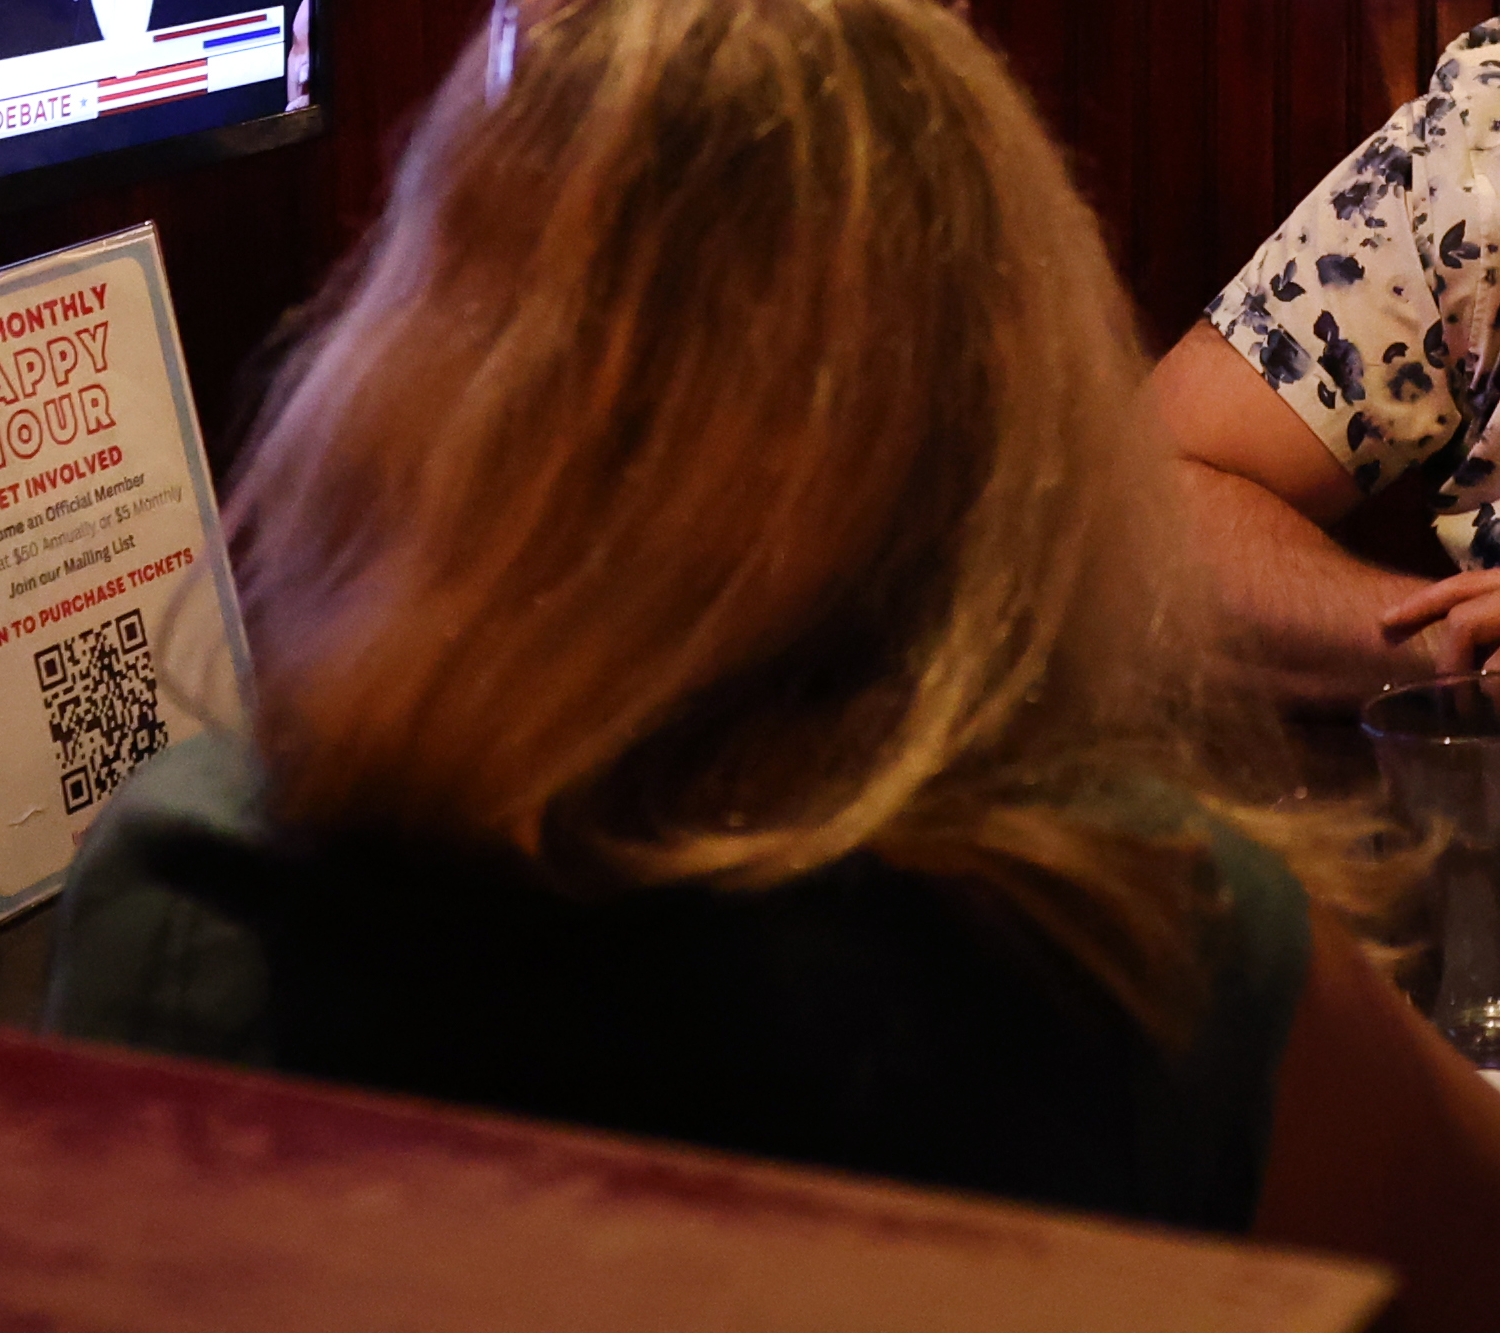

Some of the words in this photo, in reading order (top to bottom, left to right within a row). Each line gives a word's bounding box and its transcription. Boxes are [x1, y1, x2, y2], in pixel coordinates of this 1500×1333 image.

[25, 445, 123, 498] INVOLVED
[27, 515, 44, 530] an
[45, 492, 92, 522] Official
[94, 473, 144, 503] Member
[12, 541, 38, 566] $50
[42, 520, 97, 552] Annually
[99, 514, 113, 530] or
[114, 504, 131, 525] $5
[134, 485, 183, 516] Monthly
[9, 576, 38, 599] Join
[39, 566, 61, 586] our
[63, 545, 112, 576] Mailing
[112, 534, 136, 555] List
[11, 615, 36, 638] TO
[39, 576, 126, 628] PURCHASE
[127, 547, 194, 588] TICKETS
